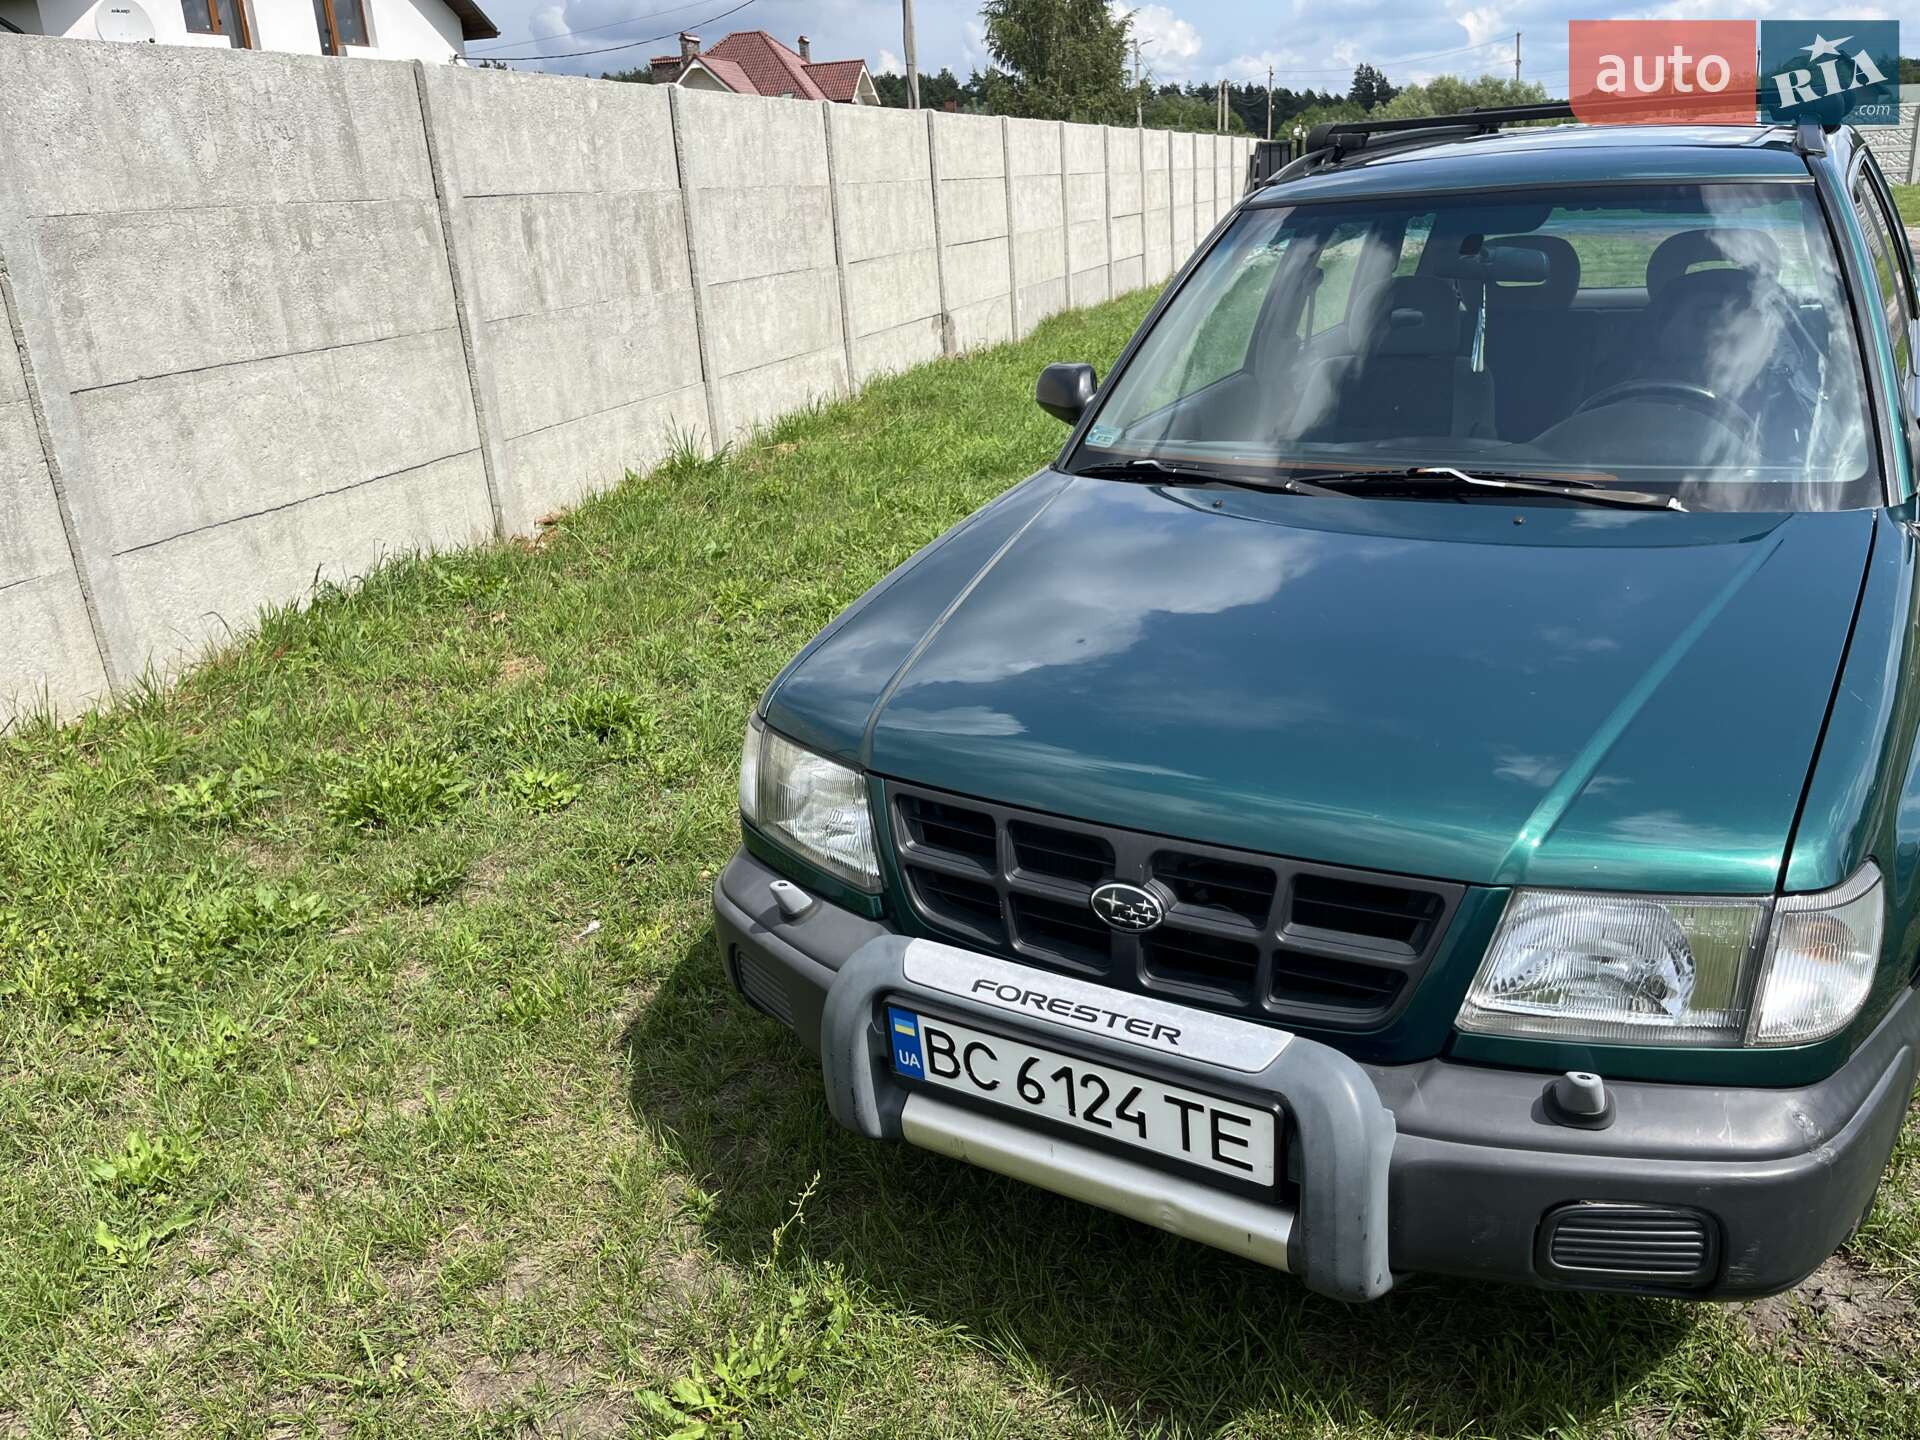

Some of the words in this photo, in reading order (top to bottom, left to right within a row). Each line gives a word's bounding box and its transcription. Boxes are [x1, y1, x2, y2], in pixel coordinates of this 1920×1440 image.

[971, 979, 1182, 1045] FORESTER
[898, 1048, 921, 1070] UA
[924, 1026, 1000, 1091] BC
[1016, 1056, 1147, 1139] 6124
[1164, 1094, 1254, 1172] TE
